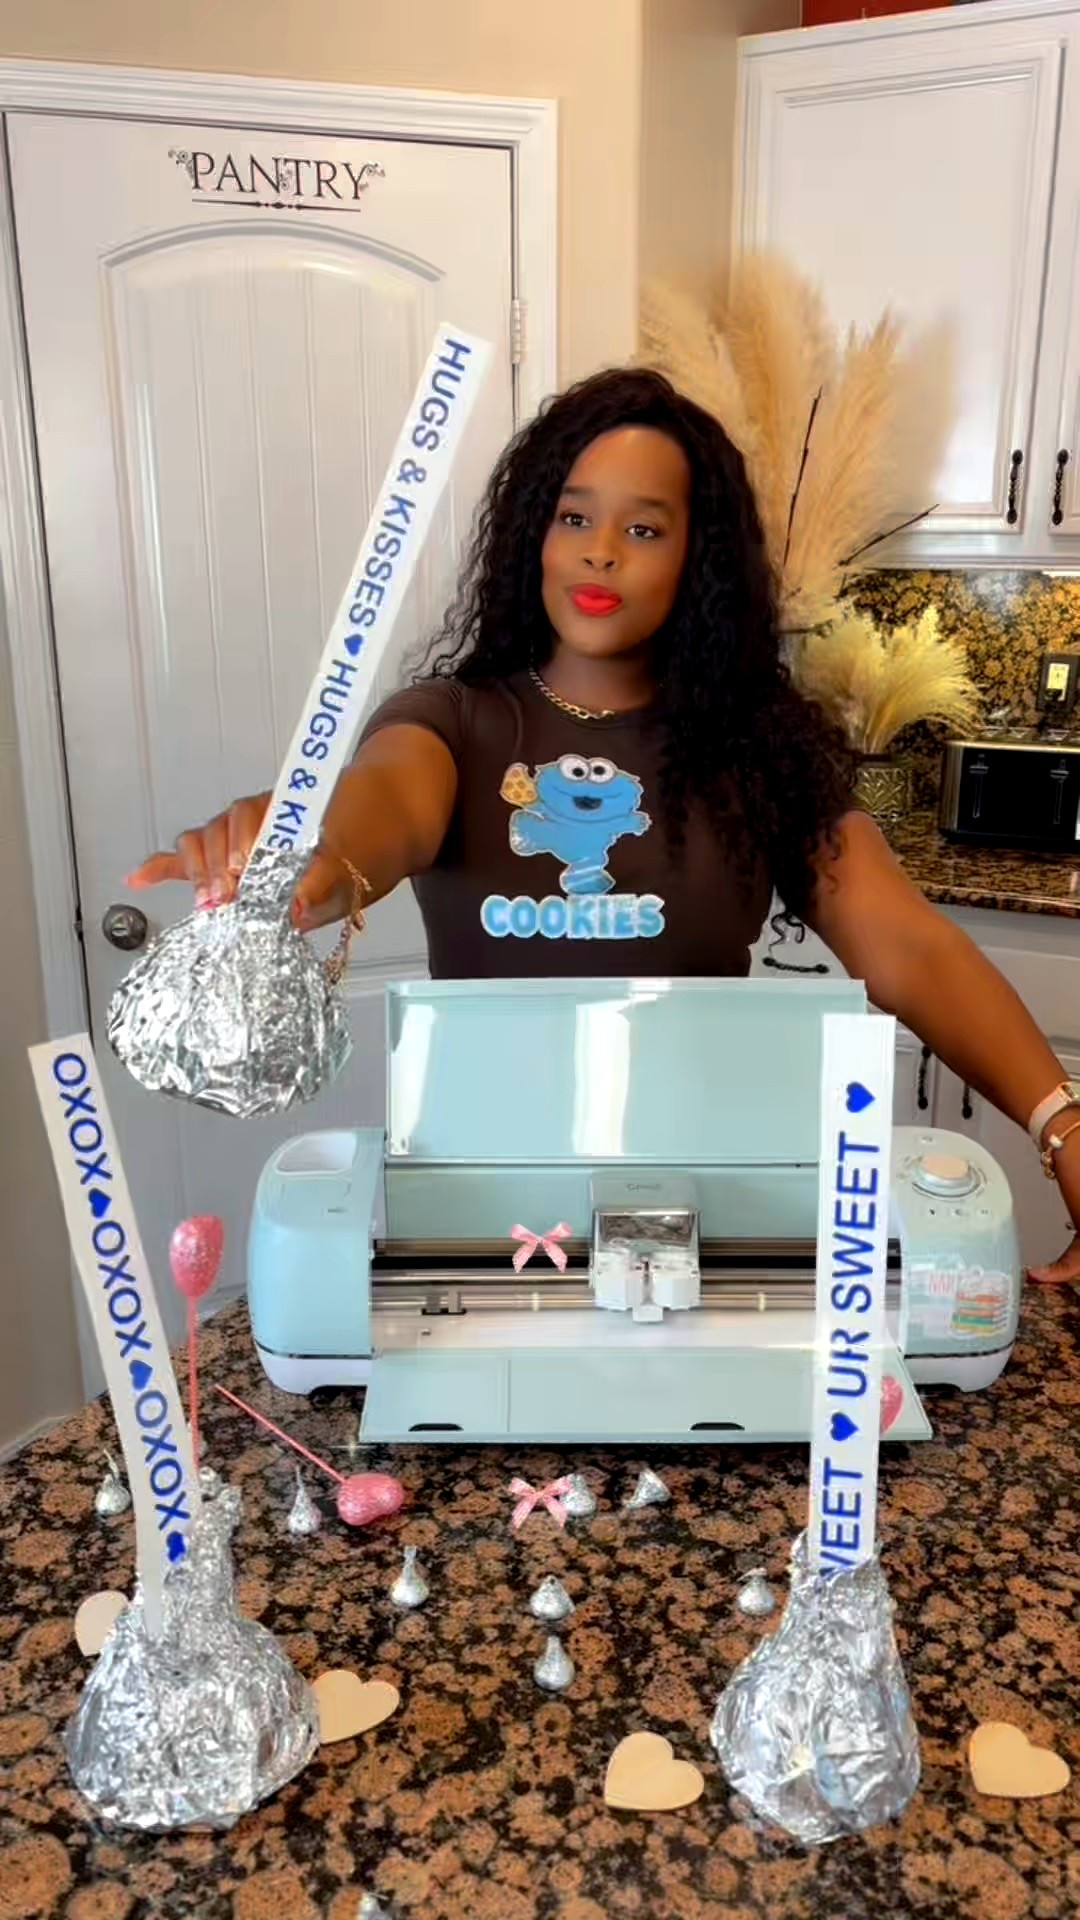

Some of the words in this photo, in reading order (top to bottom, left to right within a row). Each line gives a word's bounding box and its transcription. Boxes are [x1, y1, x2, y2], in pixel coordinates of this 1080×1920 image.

[191, 151, 371, 200] PANTRY
[411, 338, 472, 452] HUGS
[396, 457, 428, 484] &
[348, 493, 417, 628] KISSES
[301, 657, 358, 762] HUGS
[287, 767, 318, 790] &
[480, 893, 666, 940] COOKIES
[831, 1130, 880, 1314] SWEET
[53, 1052, 112, 1186] OXOX
[91, 1220, 152, 1359] OXOX
[135, 1390, 191, 1532] OXOX
[827, 1329, 870, 1398] UR
